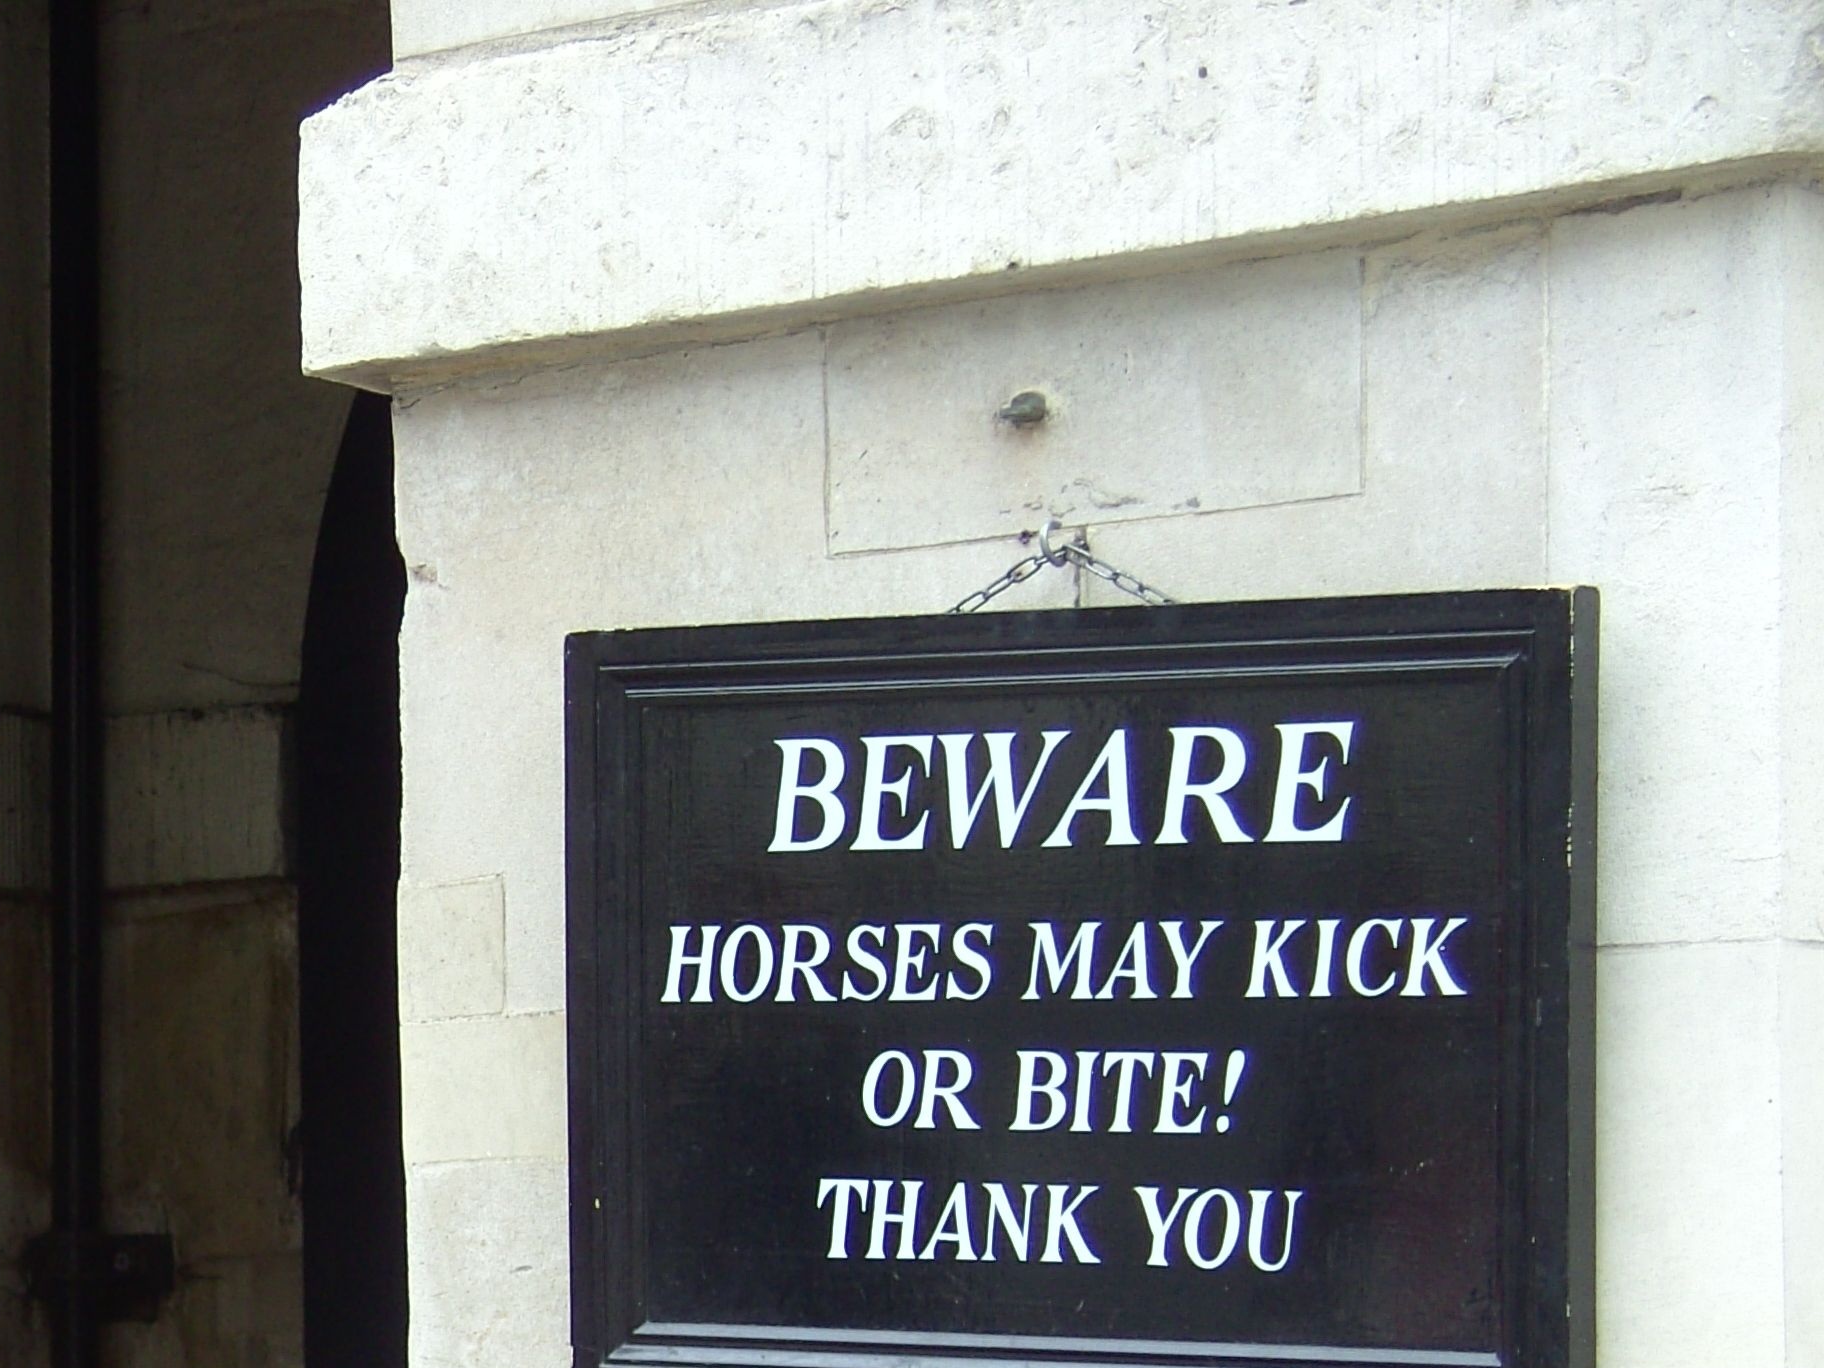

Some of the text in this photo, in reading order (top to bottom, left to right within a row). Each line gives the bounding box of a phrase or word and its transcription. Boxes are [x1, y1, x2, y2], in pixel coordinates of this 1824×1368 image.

[767, 720, 1355, 853] BEWARE
[660, 917, 1468, 1003] HORSES MAY KICK
[862, 1049, 1246, 1134] OR BITE!
[816, 1178, 1303, 1272] THANK YOU
